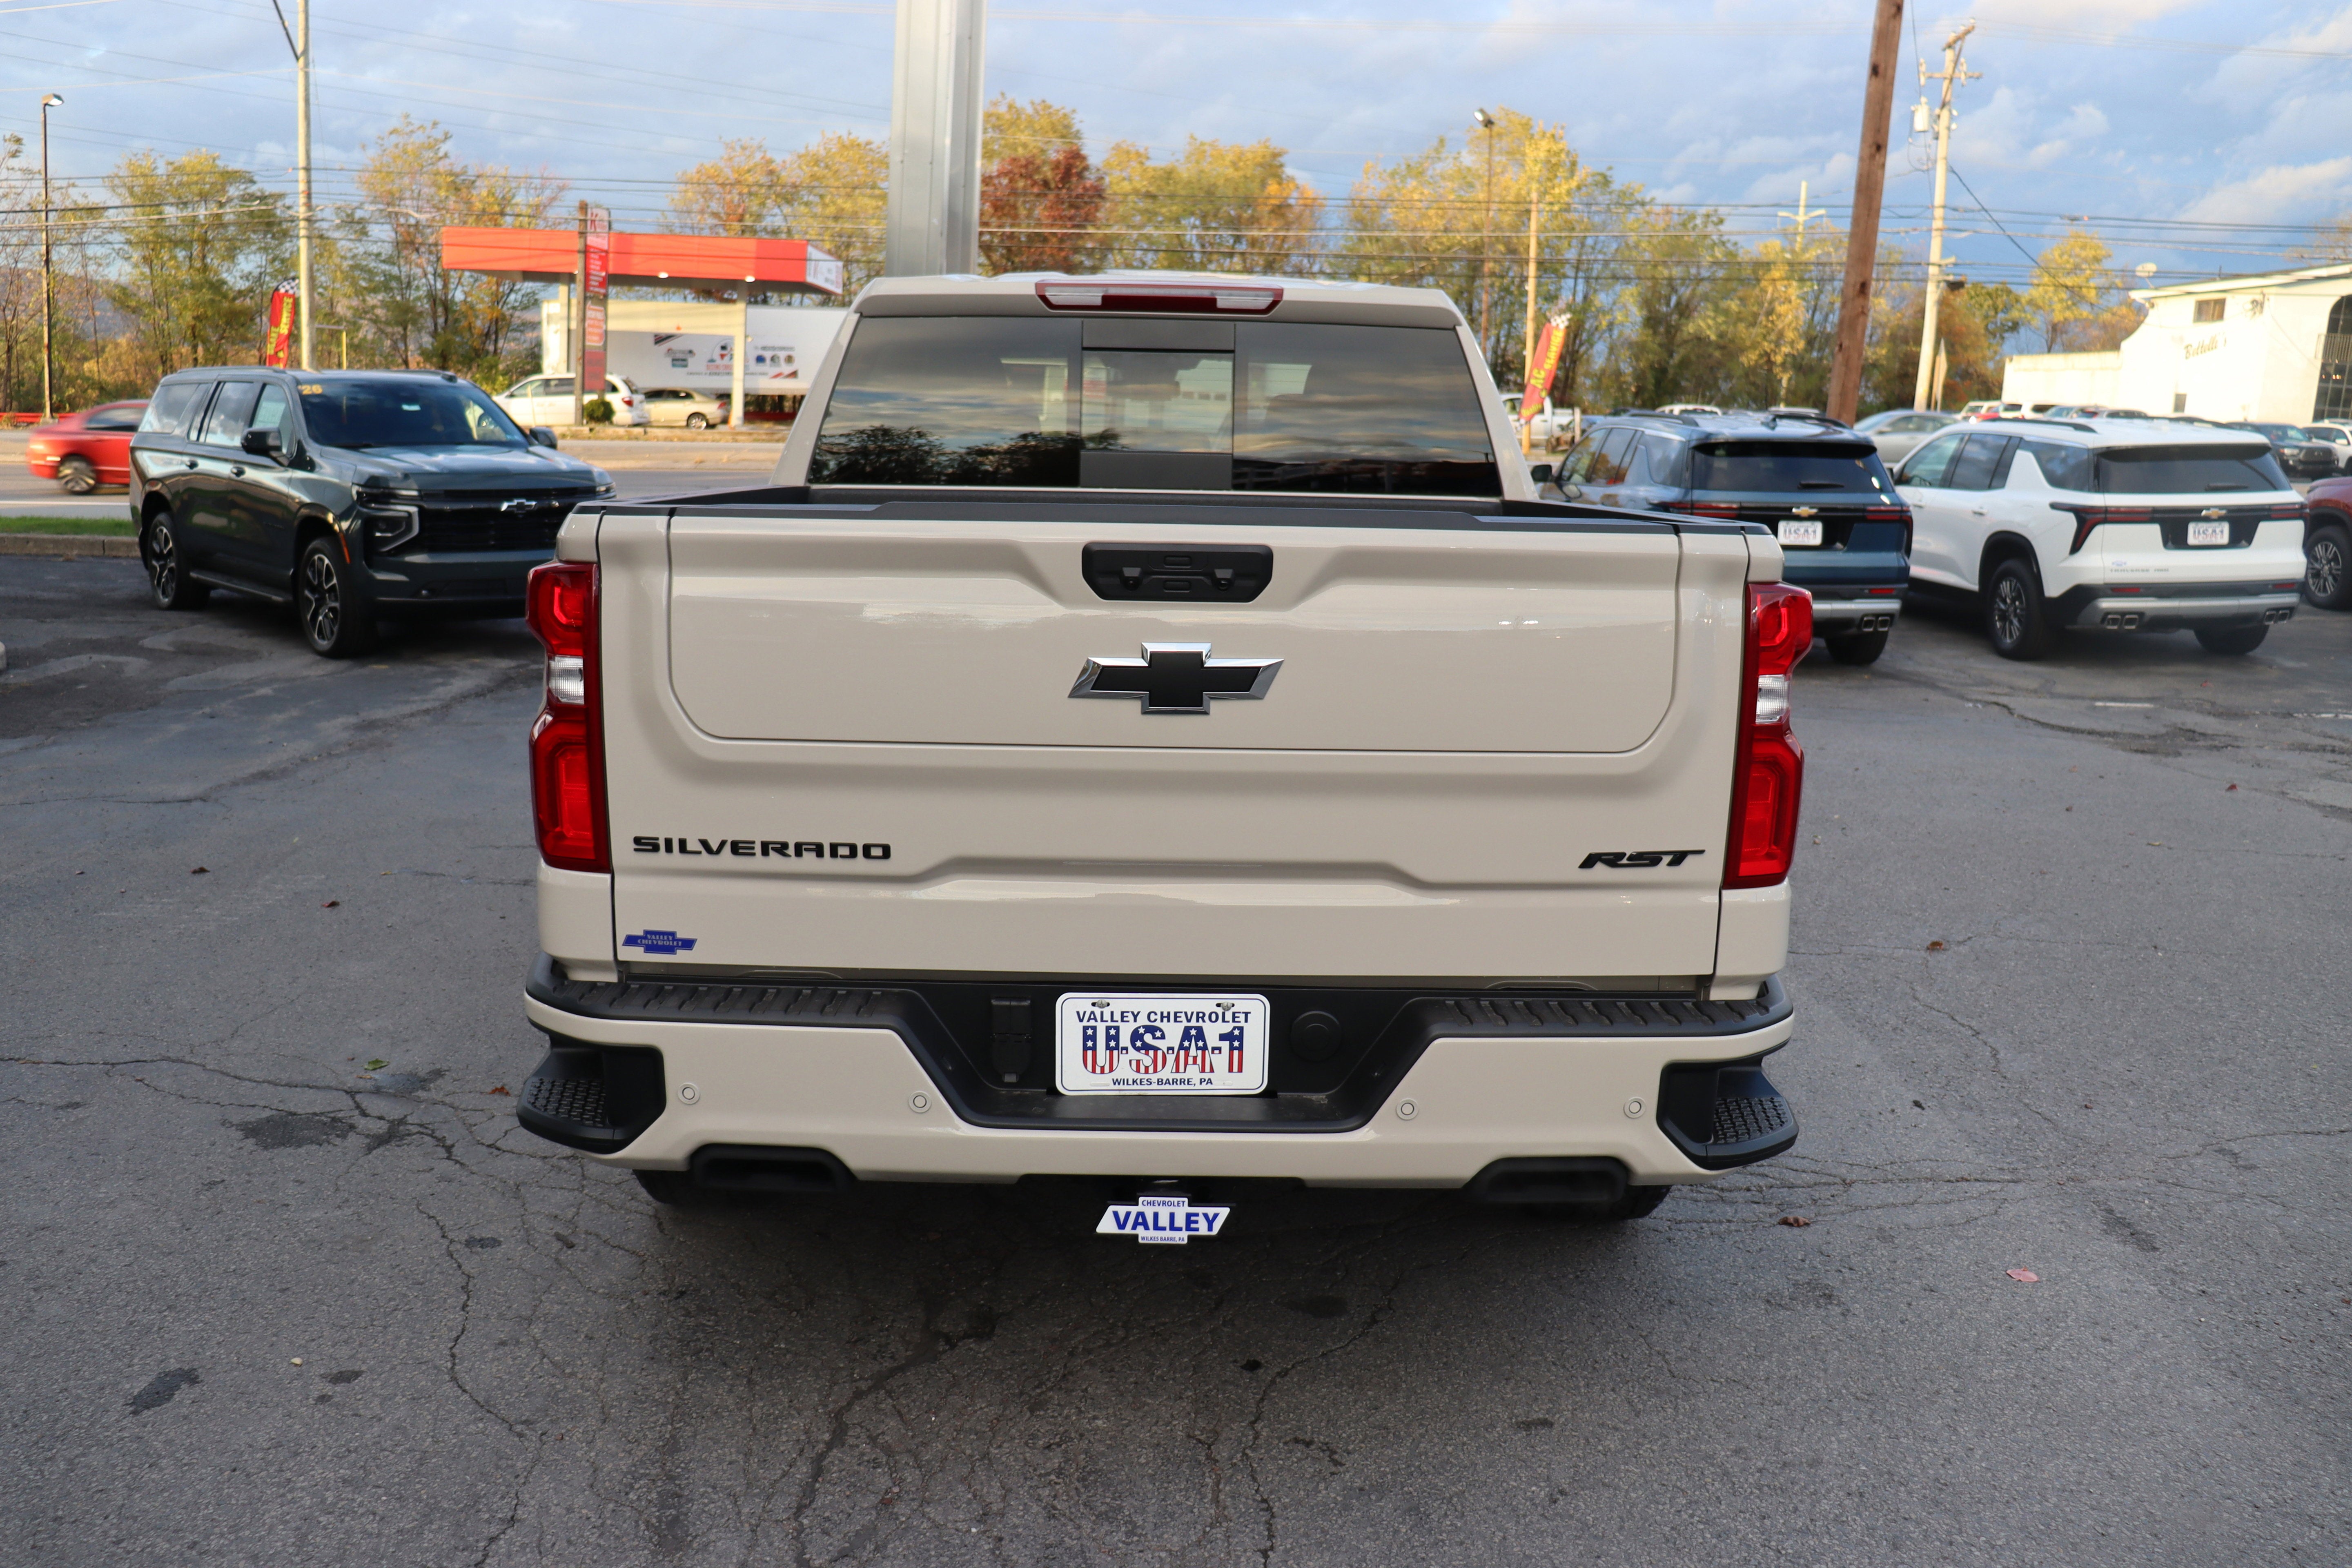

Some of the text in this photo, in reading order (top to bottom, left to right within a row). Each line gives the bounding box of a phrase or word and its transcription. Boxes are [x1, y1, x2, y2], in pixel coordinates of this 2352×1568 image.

[279, 295, 294, 335] SERVICE
[1544, 328, 1564, 369] SERVICE
[1530, 368, 1546, 389] AC
[633, 835, 891, 860] SILVERADO
[1578, 849, 1706, 869] RST
[1076, 1010, 1252, 1023] VALLEY CHEVROLET
[1111, 1078, 1213, 1087] WILKES-BARRE, PA
[1141, 1199, 1186, 1207] CHEVROLET
[1112, 1210, 1220, 1232] VALLEY
